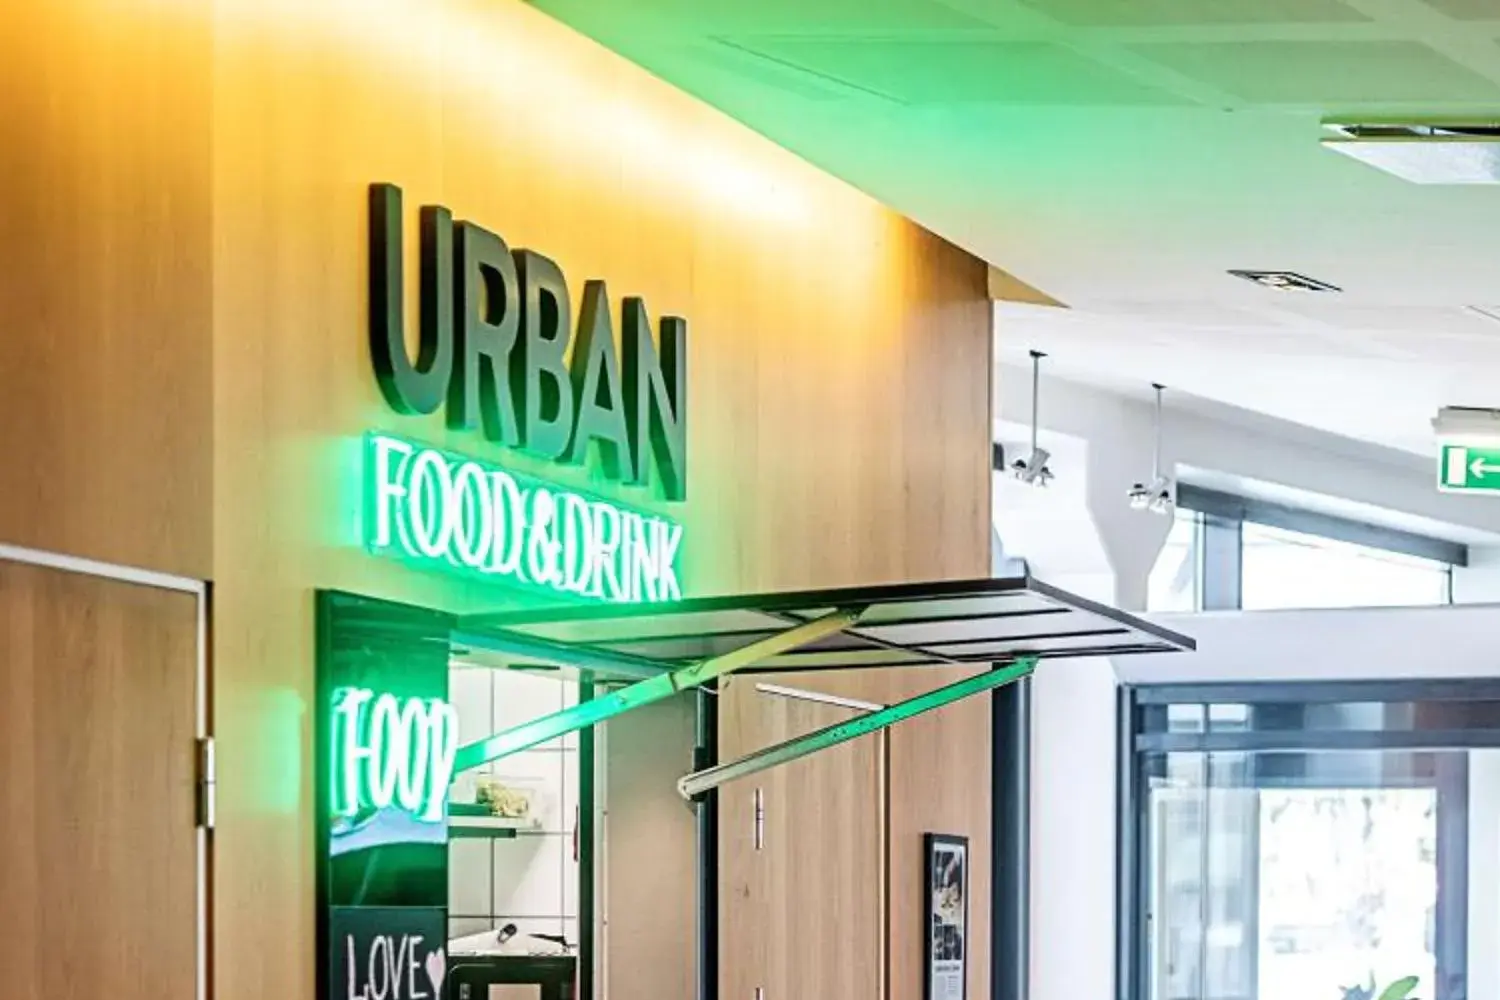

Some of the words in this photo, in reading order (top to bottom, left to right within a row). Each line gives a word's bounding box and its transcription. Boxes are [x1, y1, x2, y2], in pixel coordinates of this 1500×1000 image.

[368, 182, 687, 502] URBAN
[370, 434, 684, 603] FOOD&DRINK
[333, 686, 459, 823] FOOD
